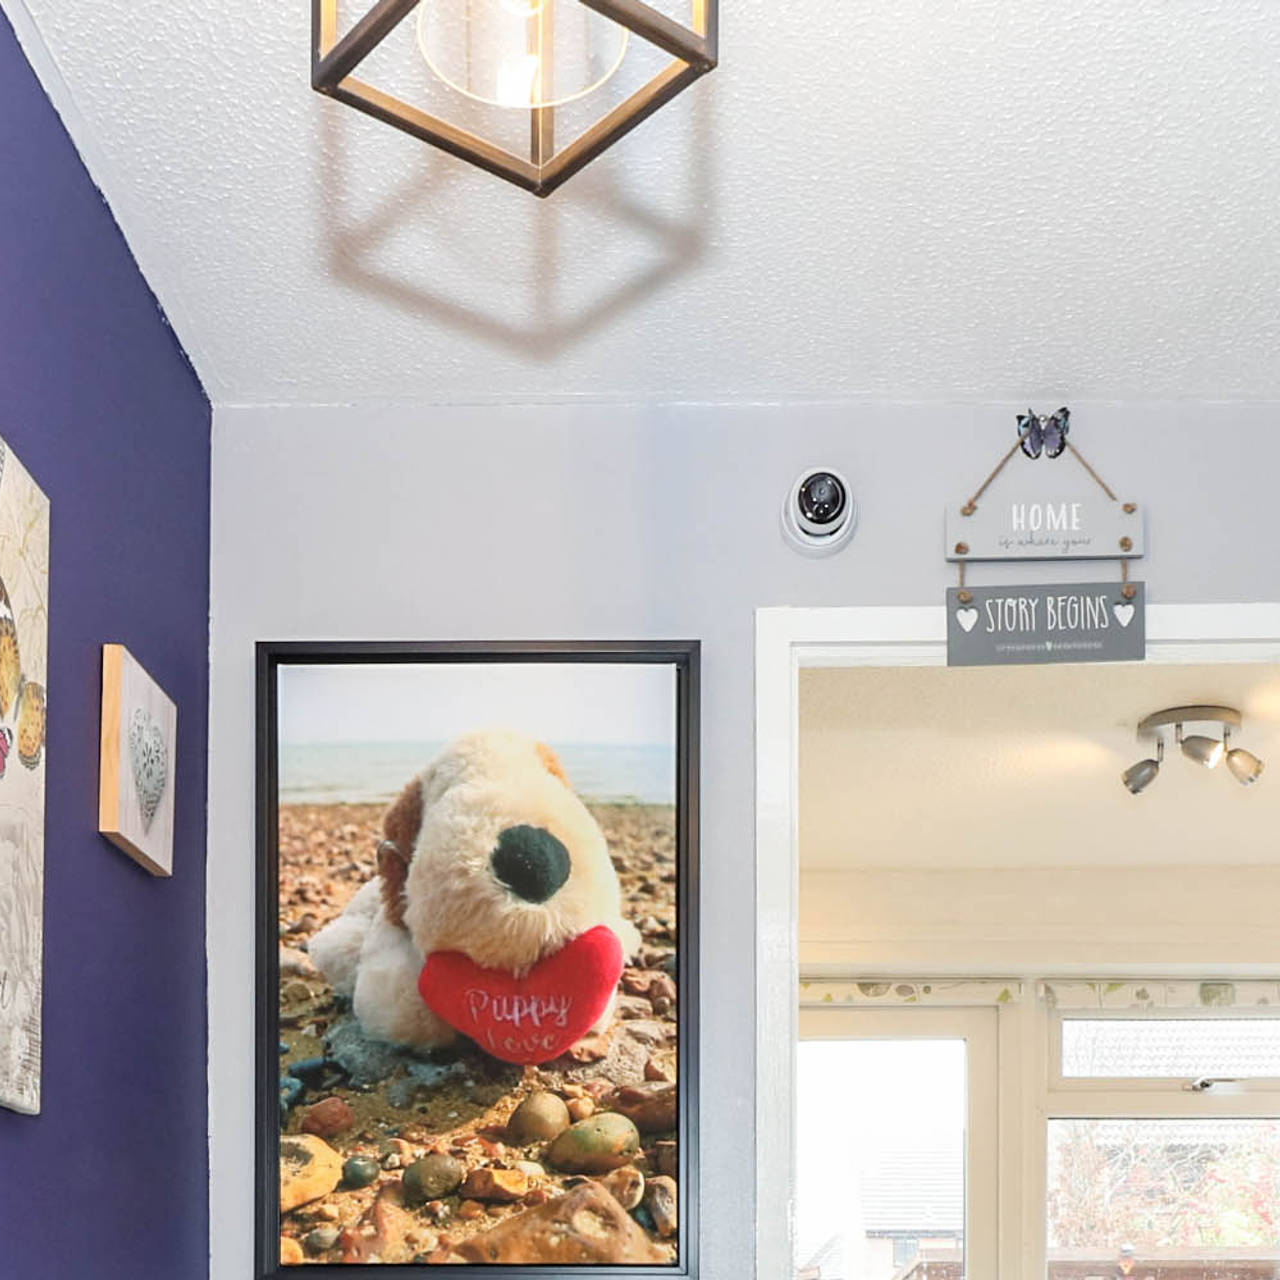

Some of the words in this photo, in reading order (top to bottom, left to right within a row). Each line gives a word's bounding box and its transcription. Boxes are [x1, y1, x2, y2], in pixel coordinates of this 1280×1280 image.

[1011, 502, 1083, 531] HOME
[985, 597, 1039, 632] STORY
[1046, 595, 1110, 631] BEGINS
[465, 988, 574, 1028] Puppy
